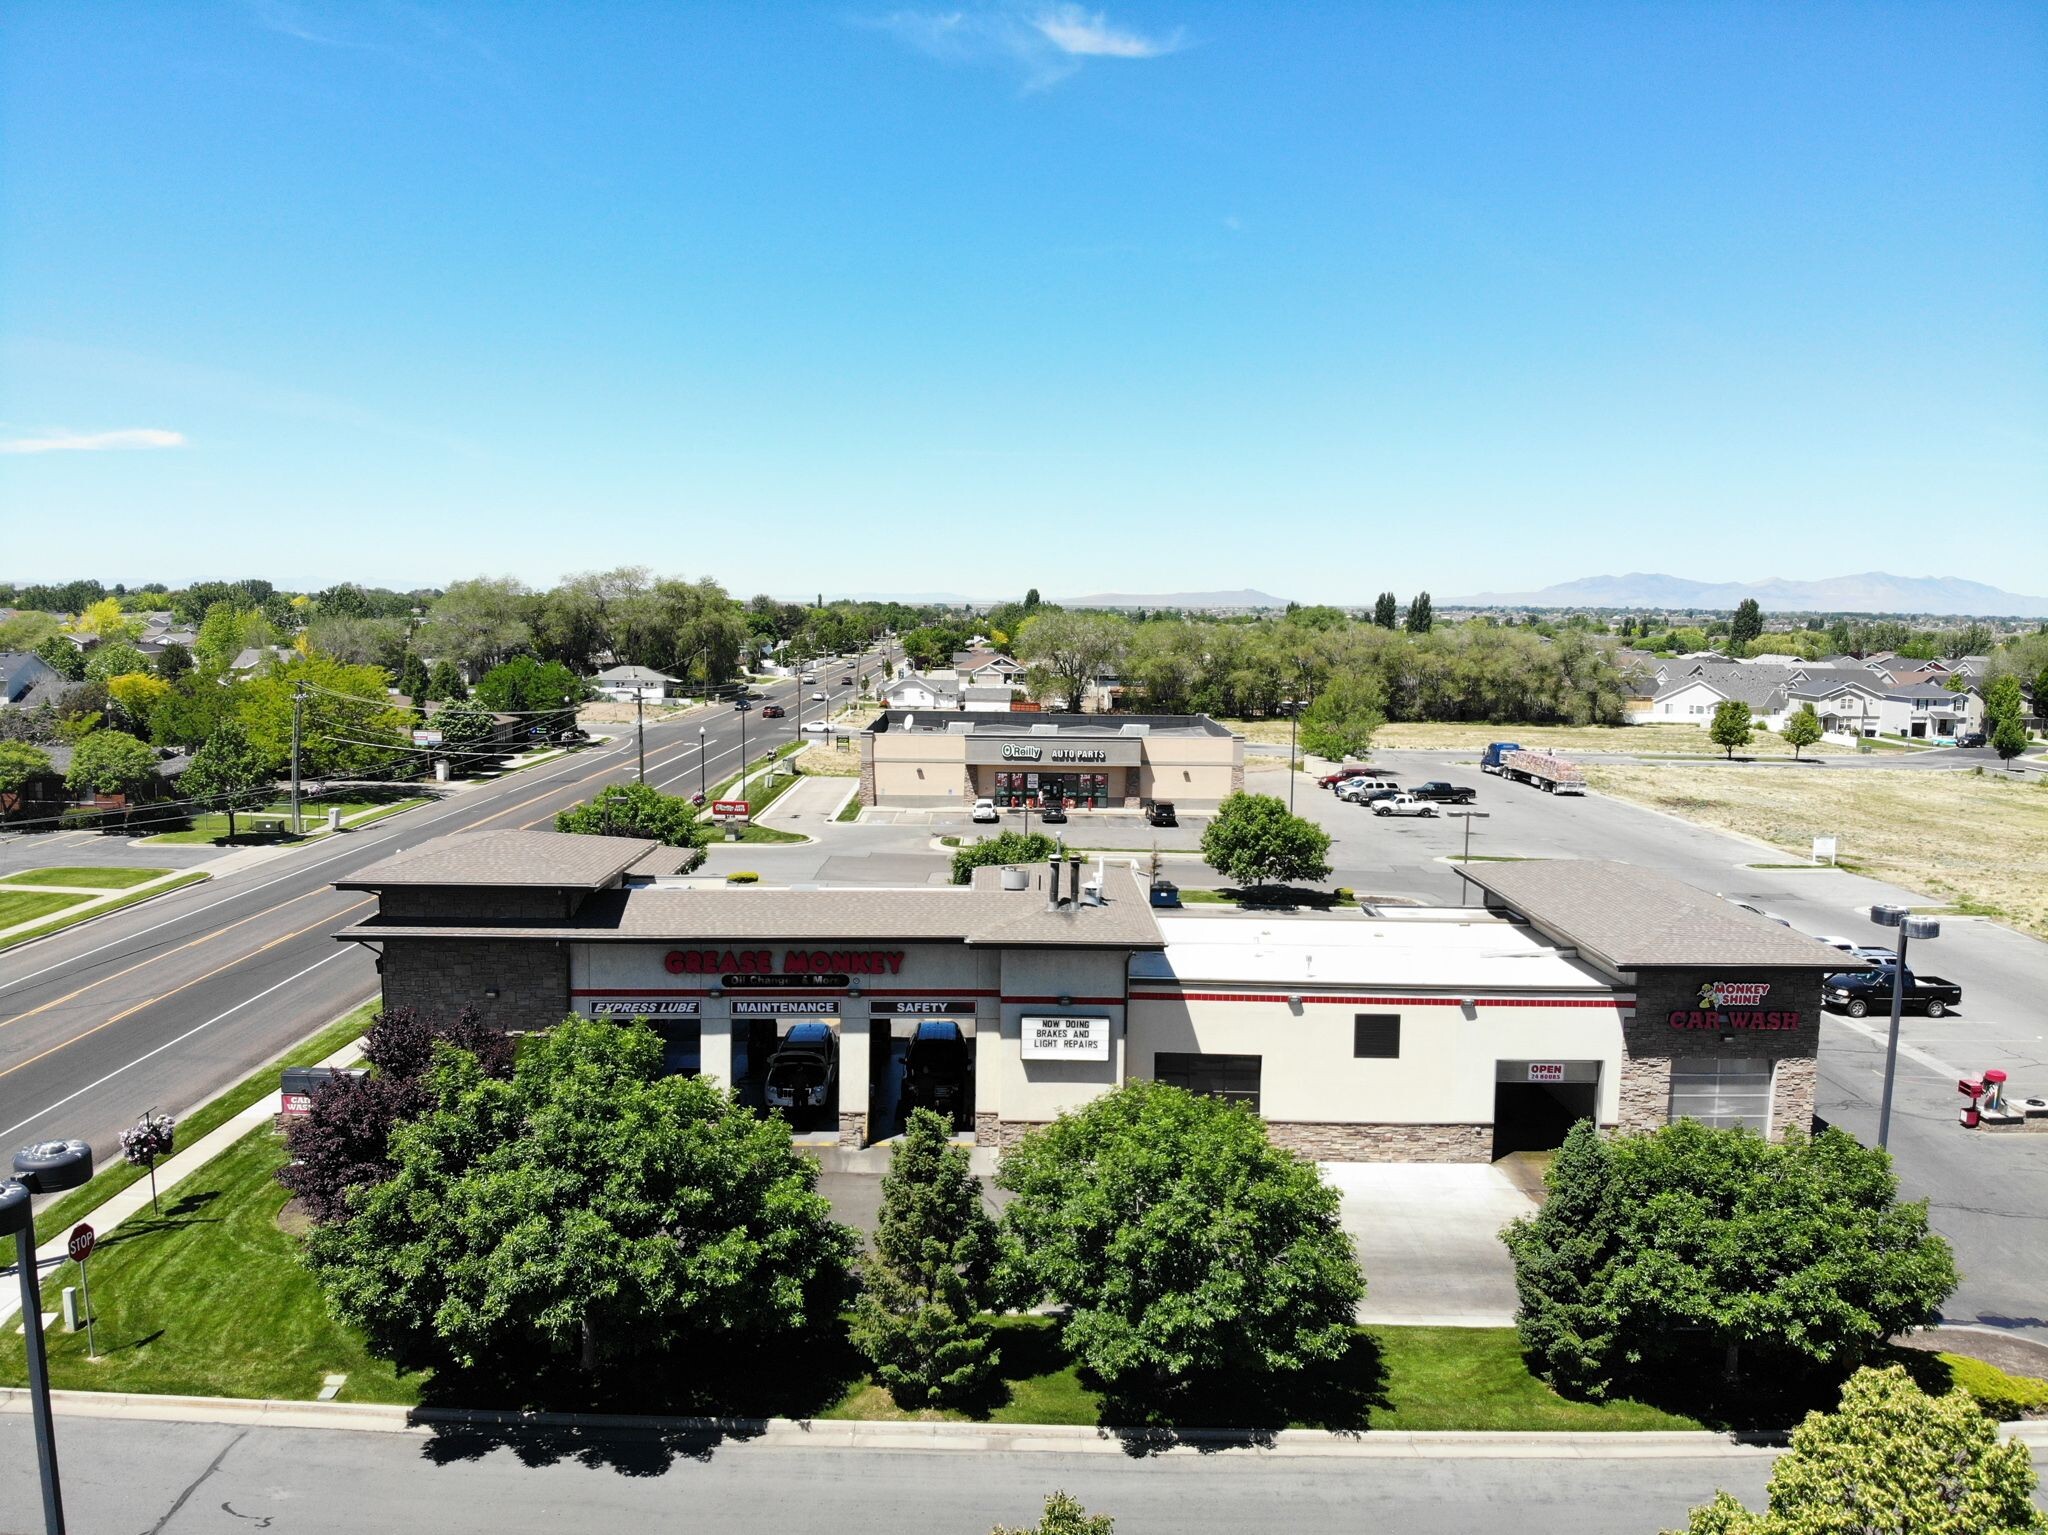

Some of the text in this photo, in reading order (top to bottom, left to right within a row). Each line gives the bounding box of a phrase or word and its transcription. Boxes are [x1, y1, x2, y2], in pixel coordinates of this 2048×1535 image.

[1002, 744, 1105, 759] O'Reilly AUTO PARTS
[664, 951, 905, 974] GREASE MONKEY
[731, 975, 745, 985] Oil
[1714, 984, 1770, 996] MONKEY
[1723, 994, 1760, 1005] SHINE
[594, 1003, 697, 1013] EXPRESS LUBE
[736, 1002, 834, 1013] MAINTENANCE
[896, 1002, 948, 1013] SAFETY
[1042, 1019, 1090, 1028] NOW DOING
[1669, 1011, 1801, 1030] CAR WASH
[1036, 1029, 1090, 1038] BRAKES AND
[1034, 1039, 1099, 1049] LIGHT REPAIRS
[1531, 1065, 1562, 1074] OPEN
[70, 1231, 93, 1255] STOP
